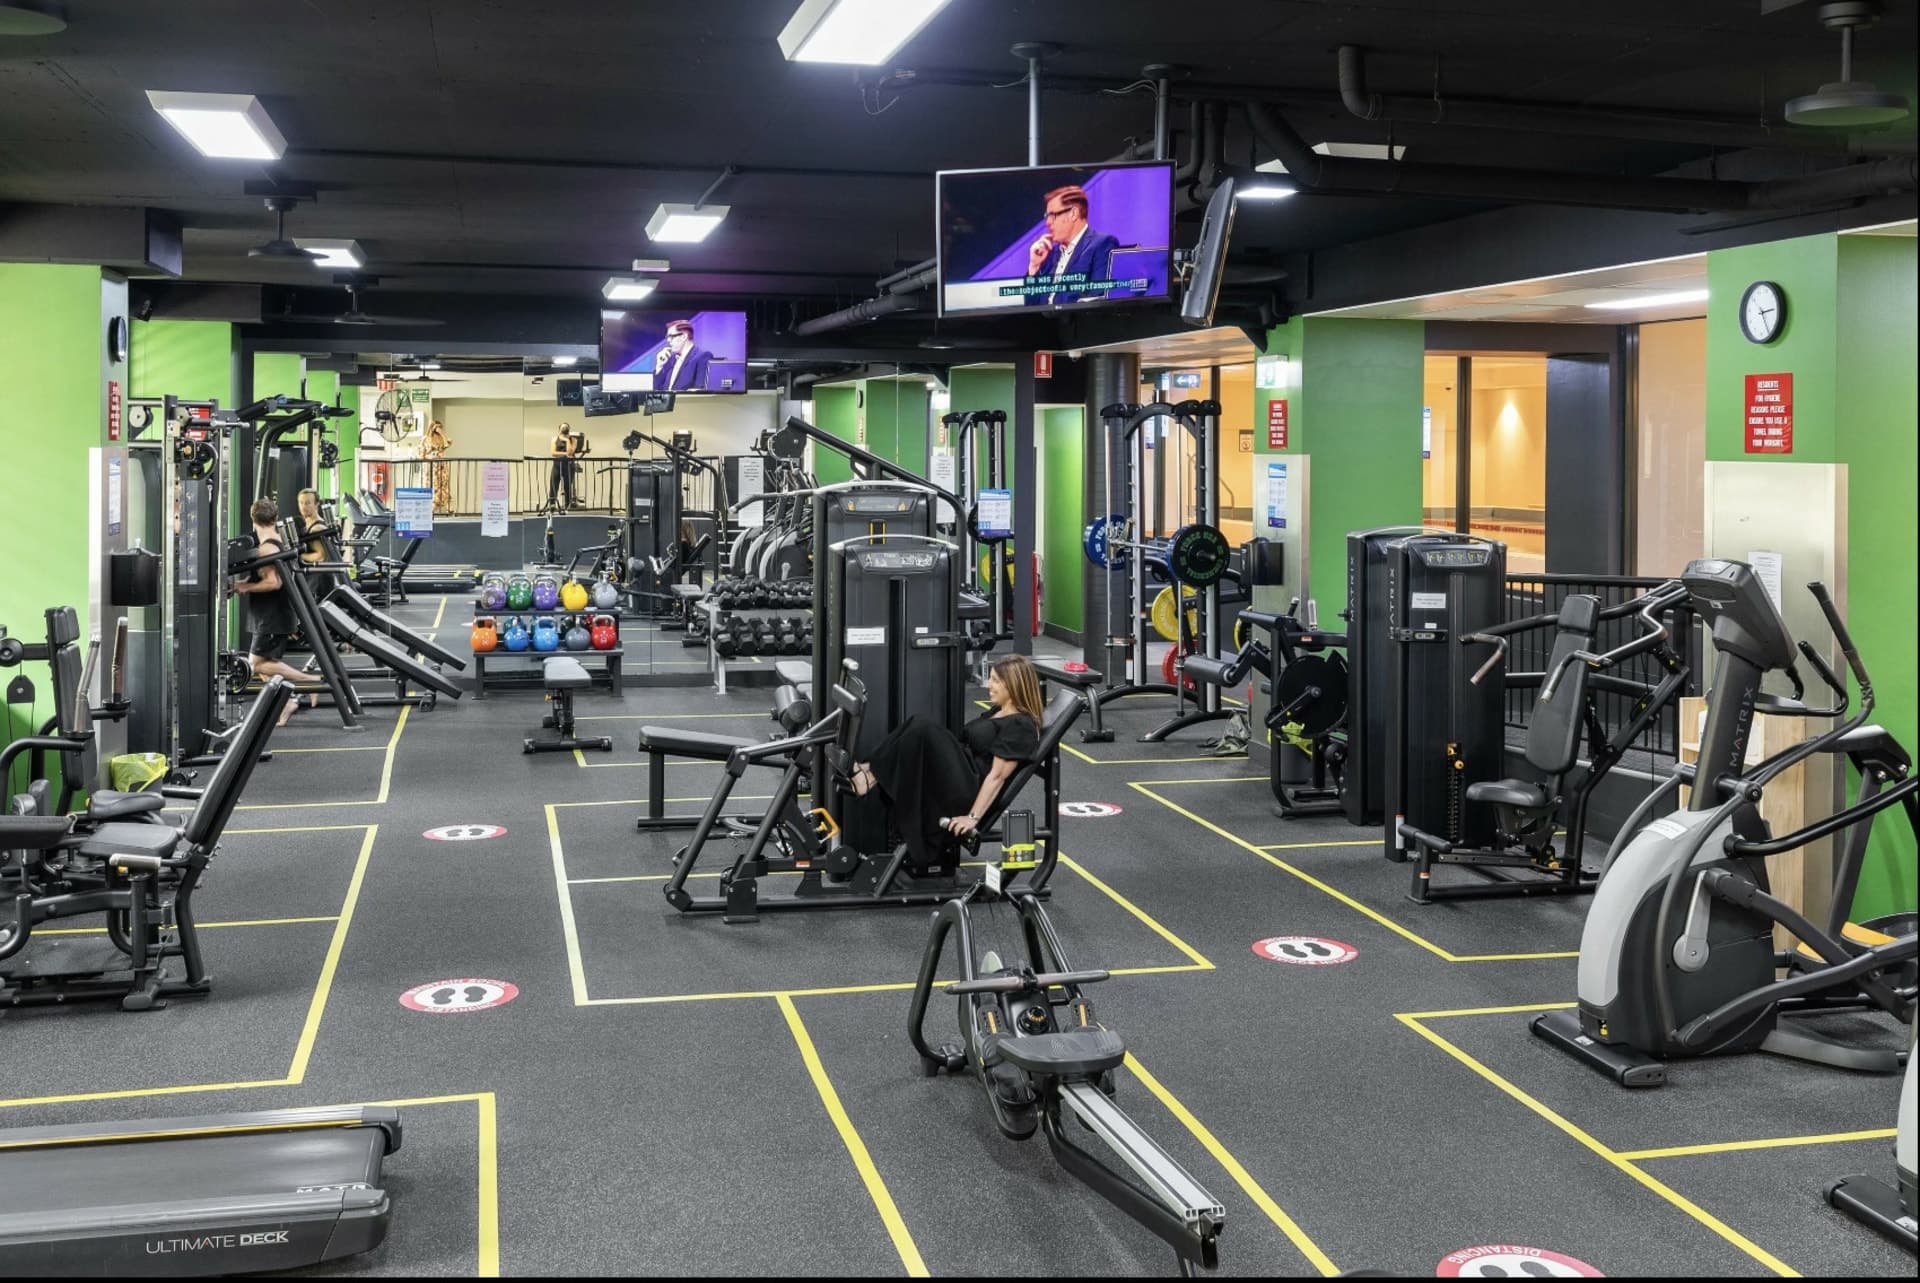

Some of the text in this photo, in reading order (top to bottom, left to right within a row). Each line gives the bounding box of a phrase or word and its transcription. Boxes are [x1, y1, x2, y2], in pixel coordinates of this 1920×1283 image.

[1729, 687, 1753, 767] MATRIX
[146, 1230, 289, 1254] ULTIMATE DECK
[1447, 1245, 1542, 1264] DISTANCING
